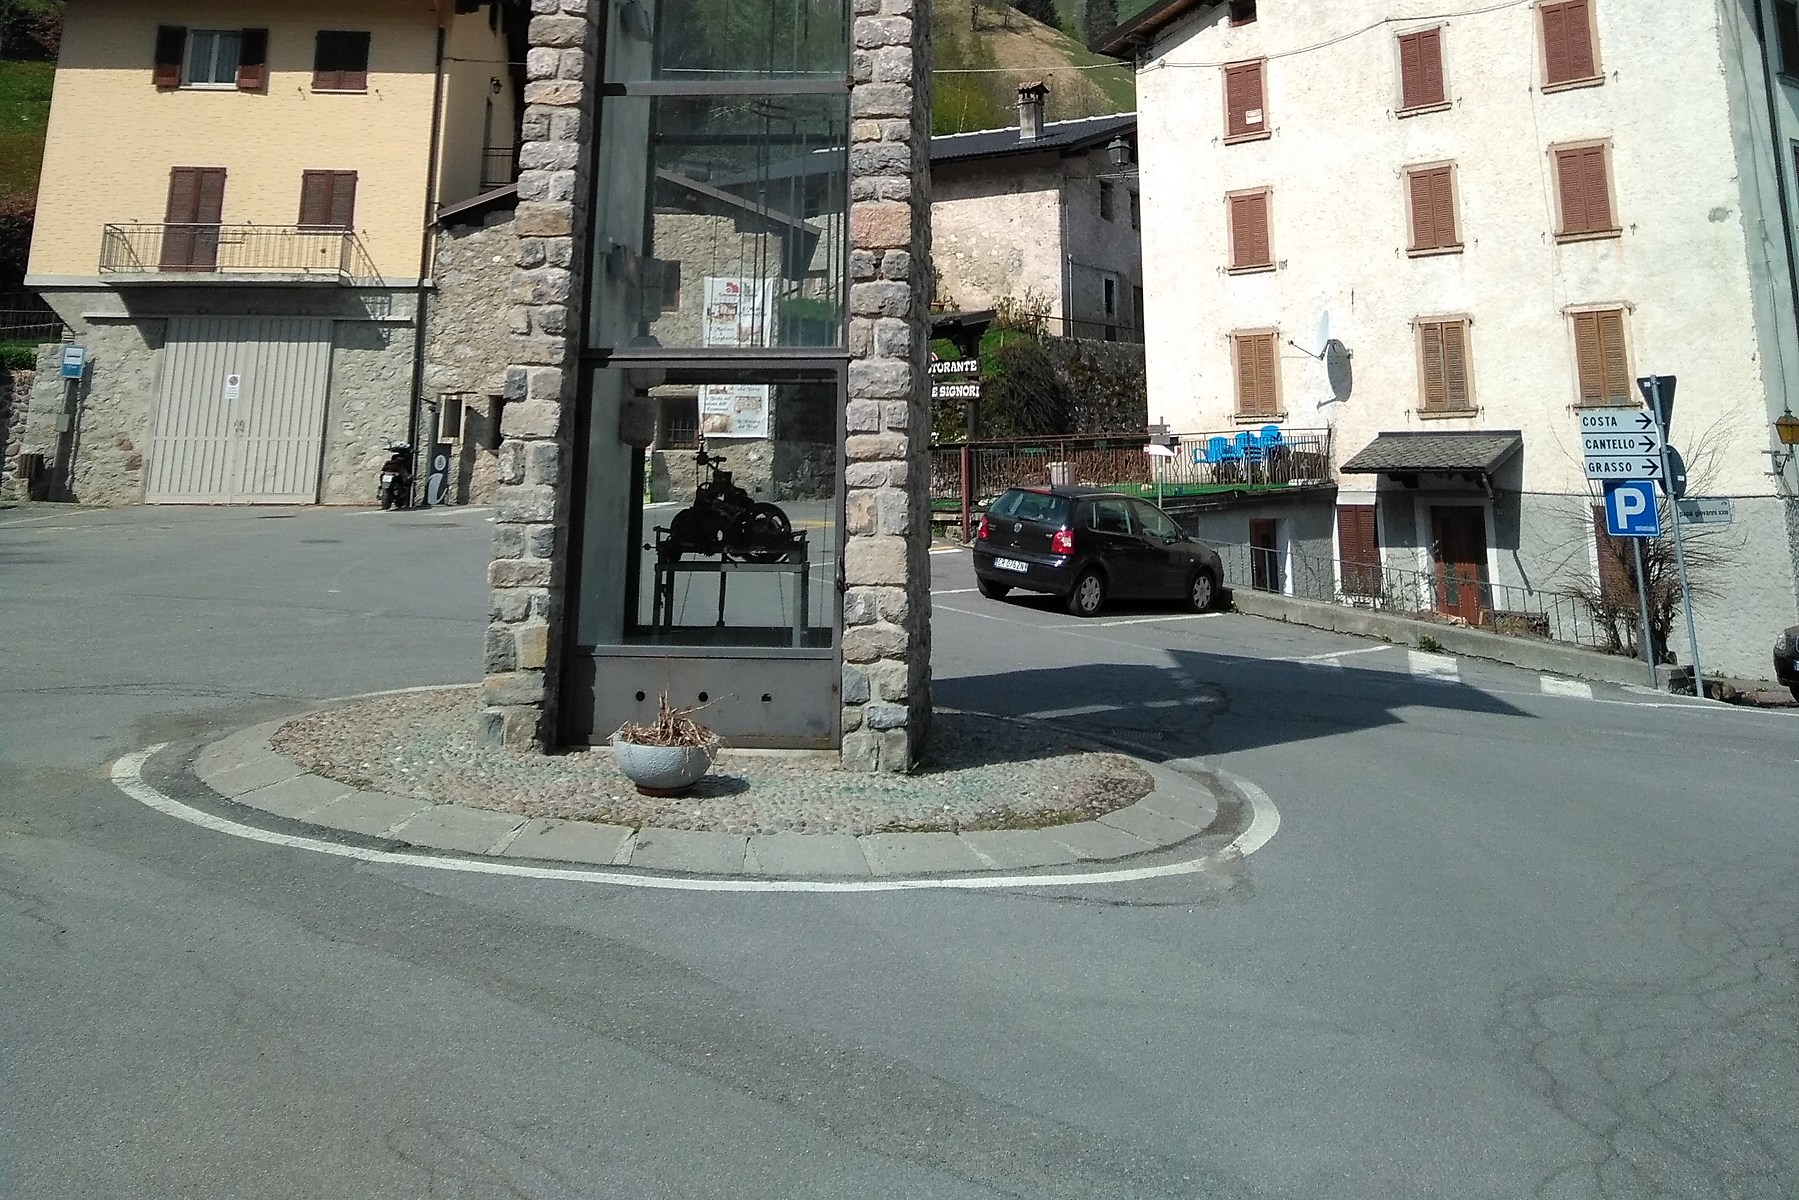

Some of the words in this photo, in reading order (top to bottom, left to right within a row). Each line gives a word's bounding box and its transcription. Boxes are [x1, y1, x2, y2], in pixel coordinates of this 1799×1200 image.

[939, 385, 980, 397] SIGNORI
[1582, 416, 1618, 427] COSTA
[1585, 439, 1635, 449] CANTELLO
[1588, 462, 1632, 472] GRASSO
[1614, 487, 1646, 529] P
